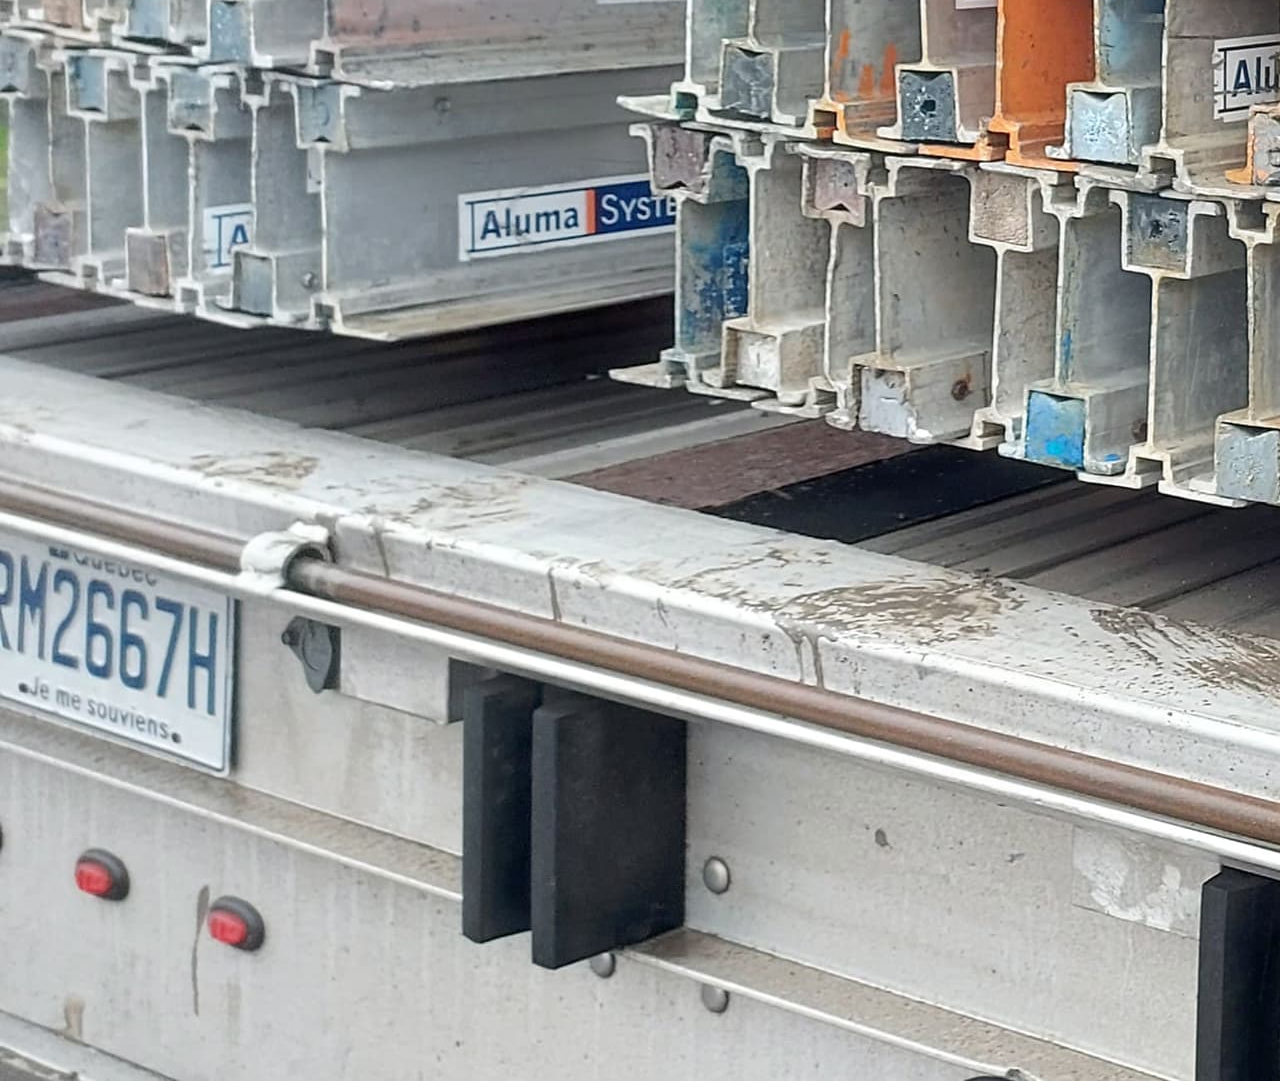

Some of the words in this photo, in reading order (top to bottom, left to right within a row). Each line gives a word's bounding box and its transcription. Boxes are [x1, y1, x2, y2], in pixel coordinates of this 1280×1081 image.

[480, 207, 580, 240] Aluma
[30, 677, 50, 700] Je
[56, 688, 83, 711] me
[87, 698, 170, 740] souviens
